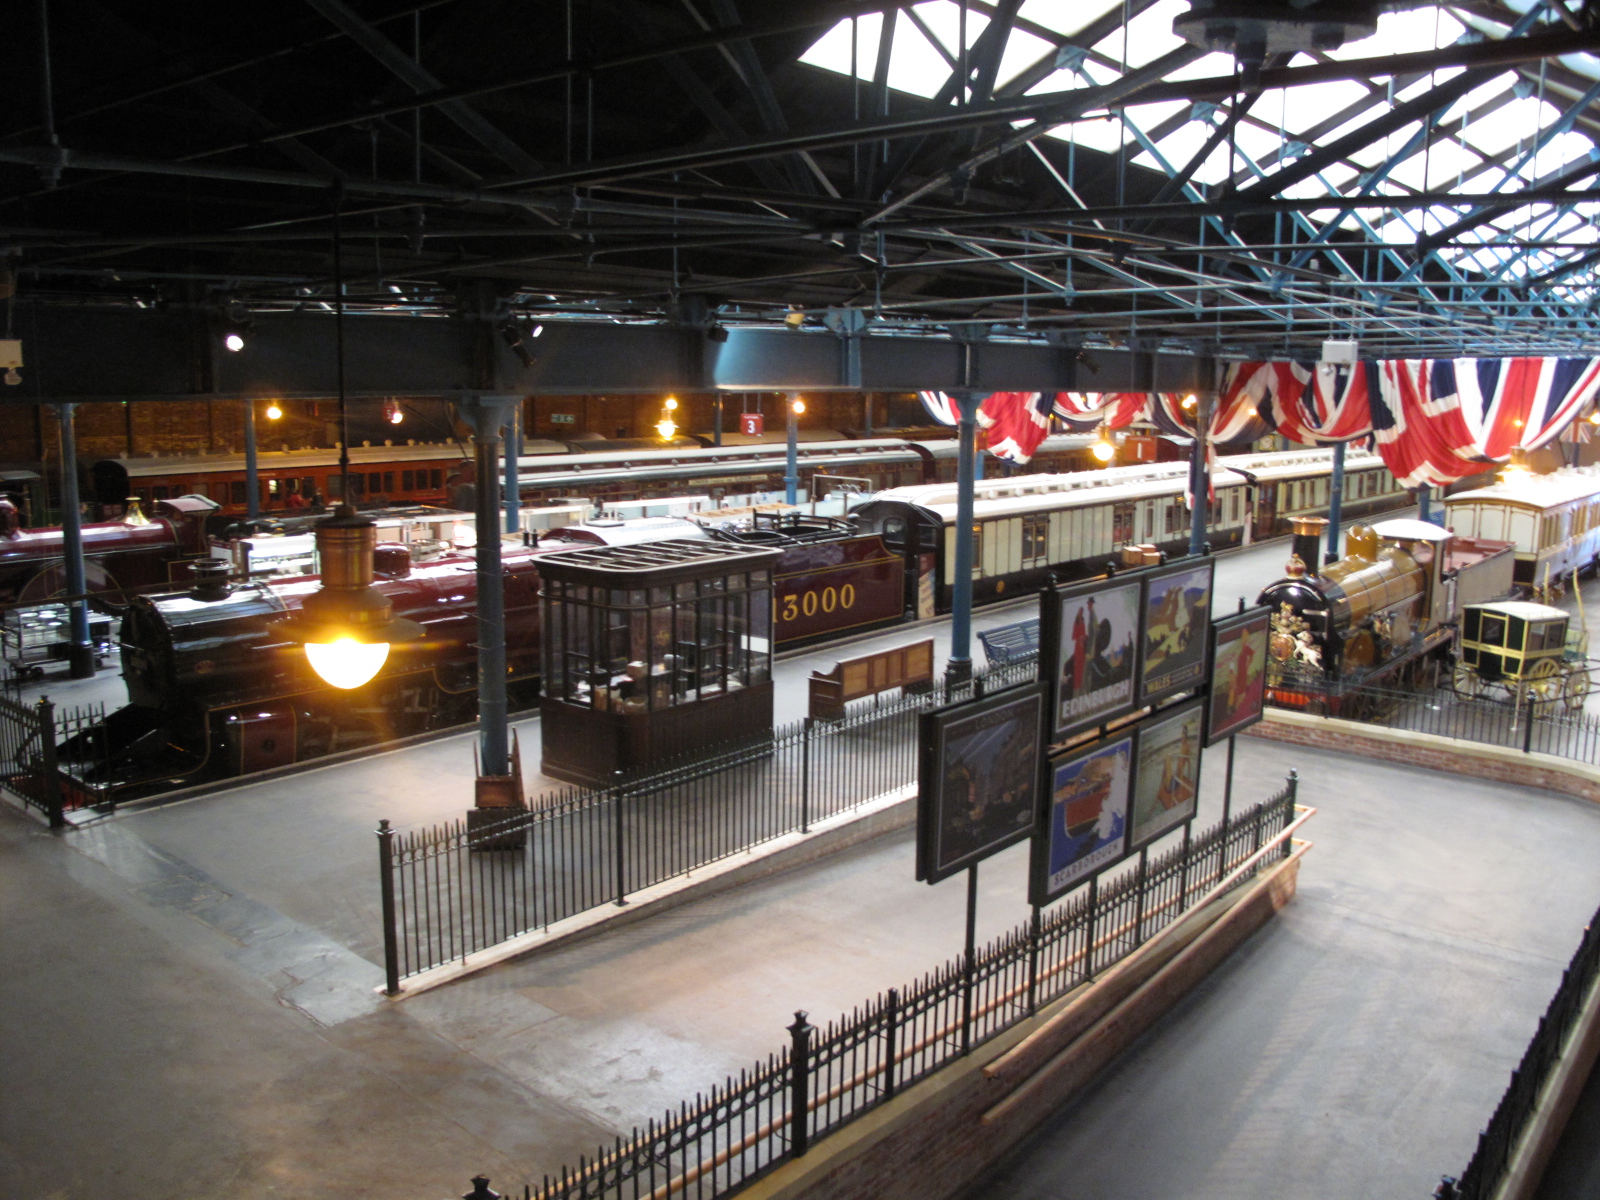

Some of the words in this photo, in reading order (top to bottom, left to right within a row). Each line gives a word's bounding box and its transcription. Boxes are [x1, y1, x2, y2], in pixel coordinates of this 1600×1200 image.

[747, 420, 756, 434] 3
[1137, 442, 1143, 459] 1
[772, 584, 855, 623] 13000
[1061, 679, 1130, 718] EDINBURGH
[1146, 675, 1171, 694] WALES
[1054, 841, 1118, 886] SCARBOROUGH
